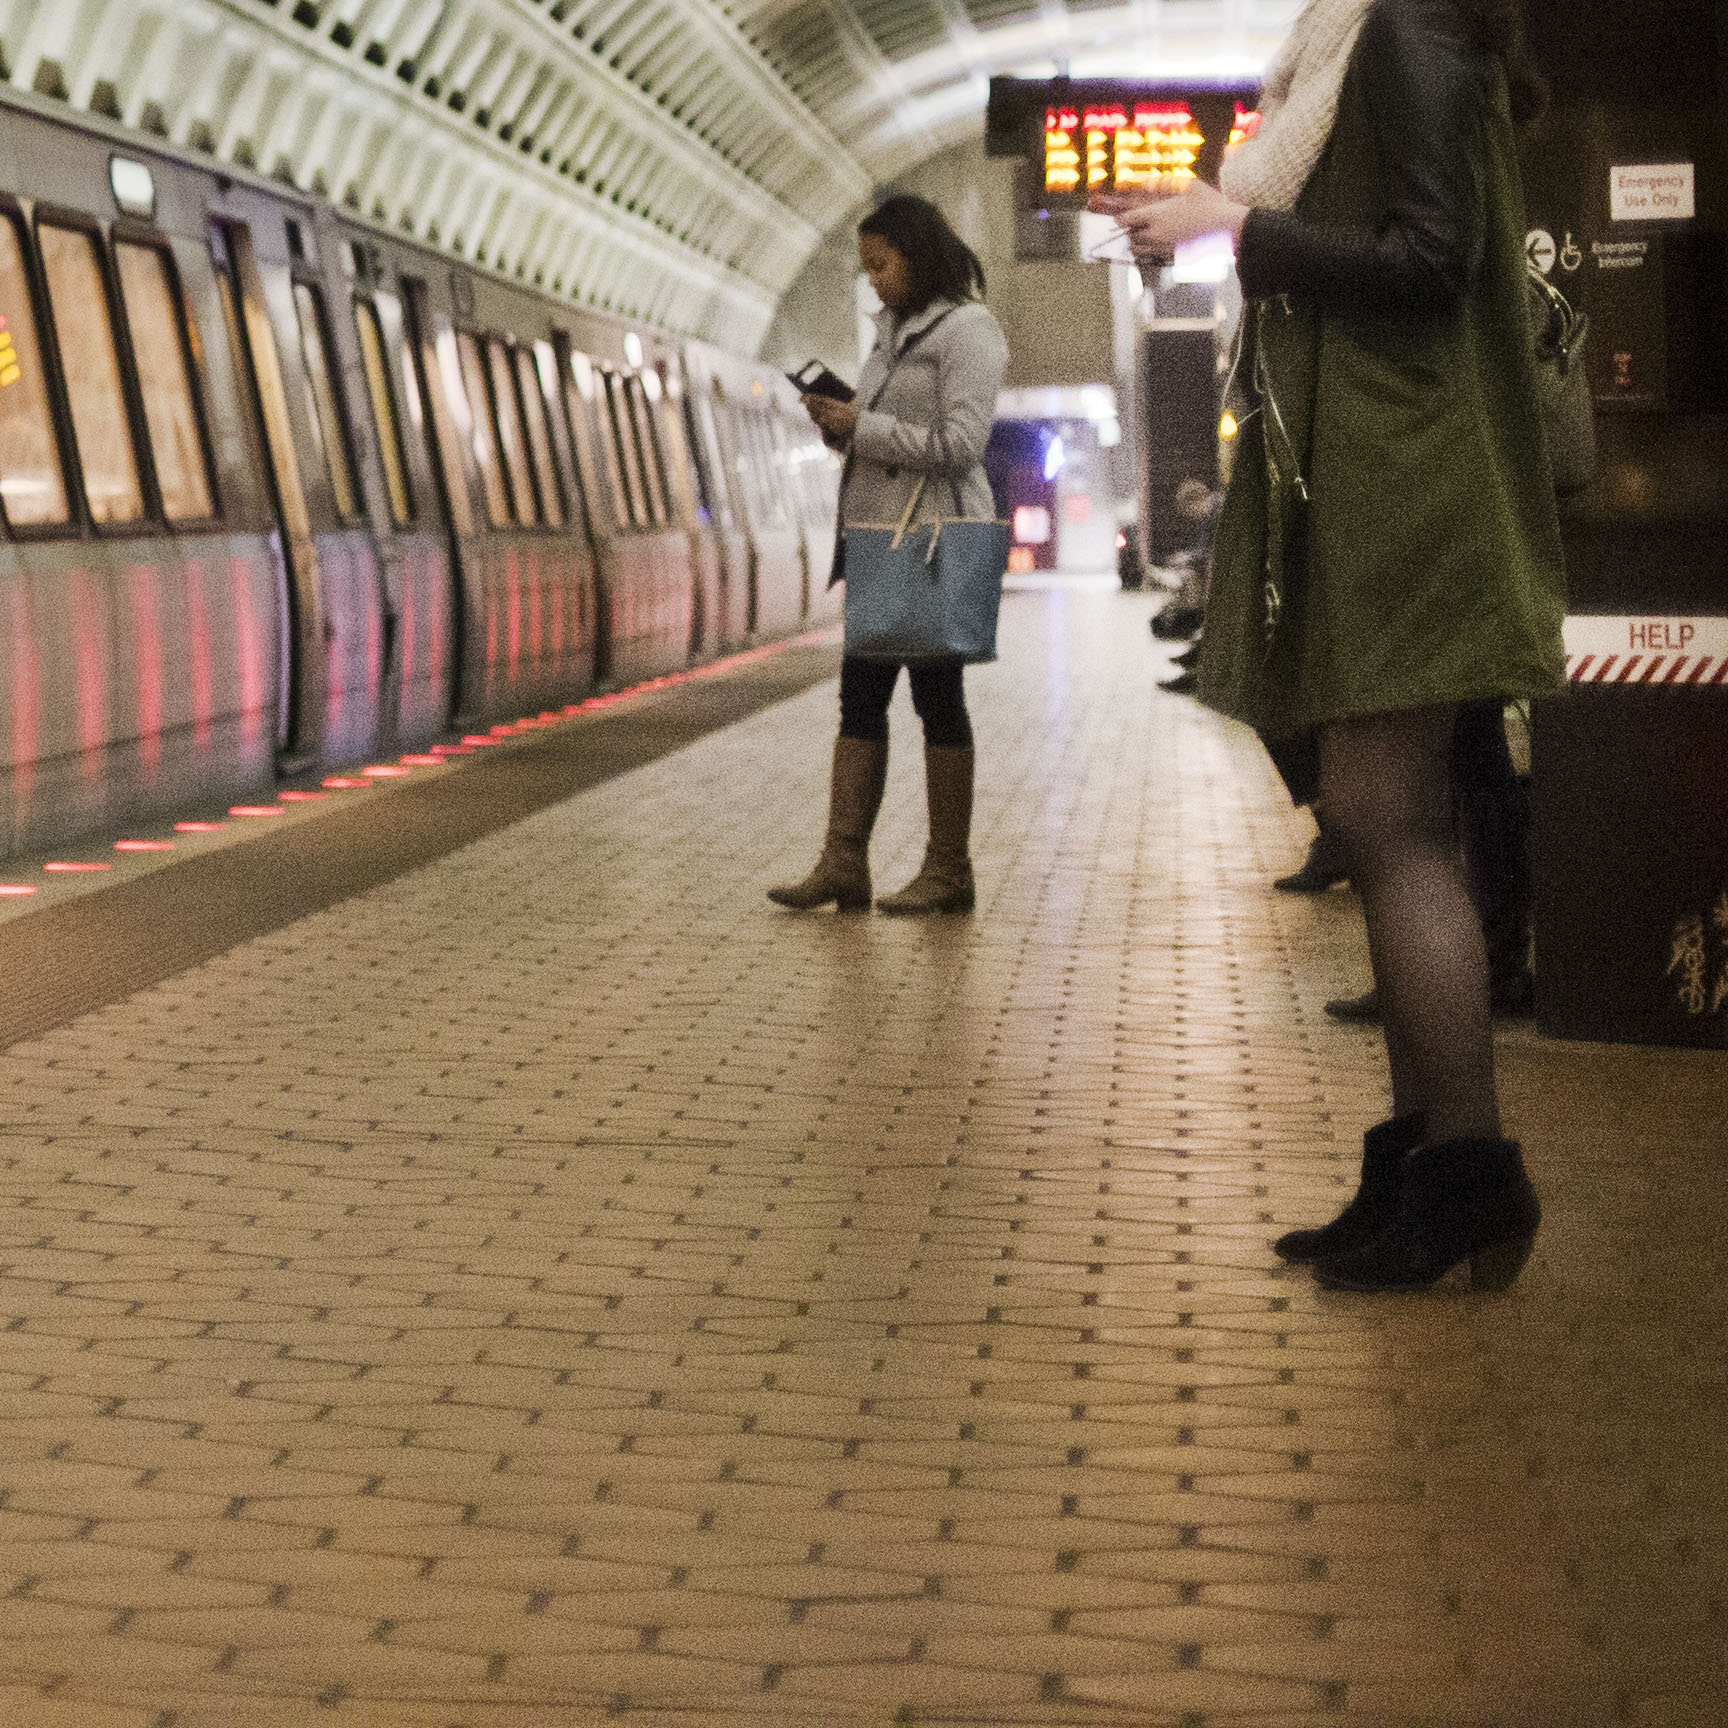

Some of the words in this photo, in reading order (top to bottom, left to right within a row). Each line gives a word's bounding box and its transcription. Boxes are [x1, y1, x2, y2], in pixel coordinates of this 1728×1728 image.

[1617, 174, 1685, 191] Emergency
[1624, 194, 1648, 208] Use
[1651, 192, 1680, 208] Only
[1629, 623, 1696, 649] HELP
